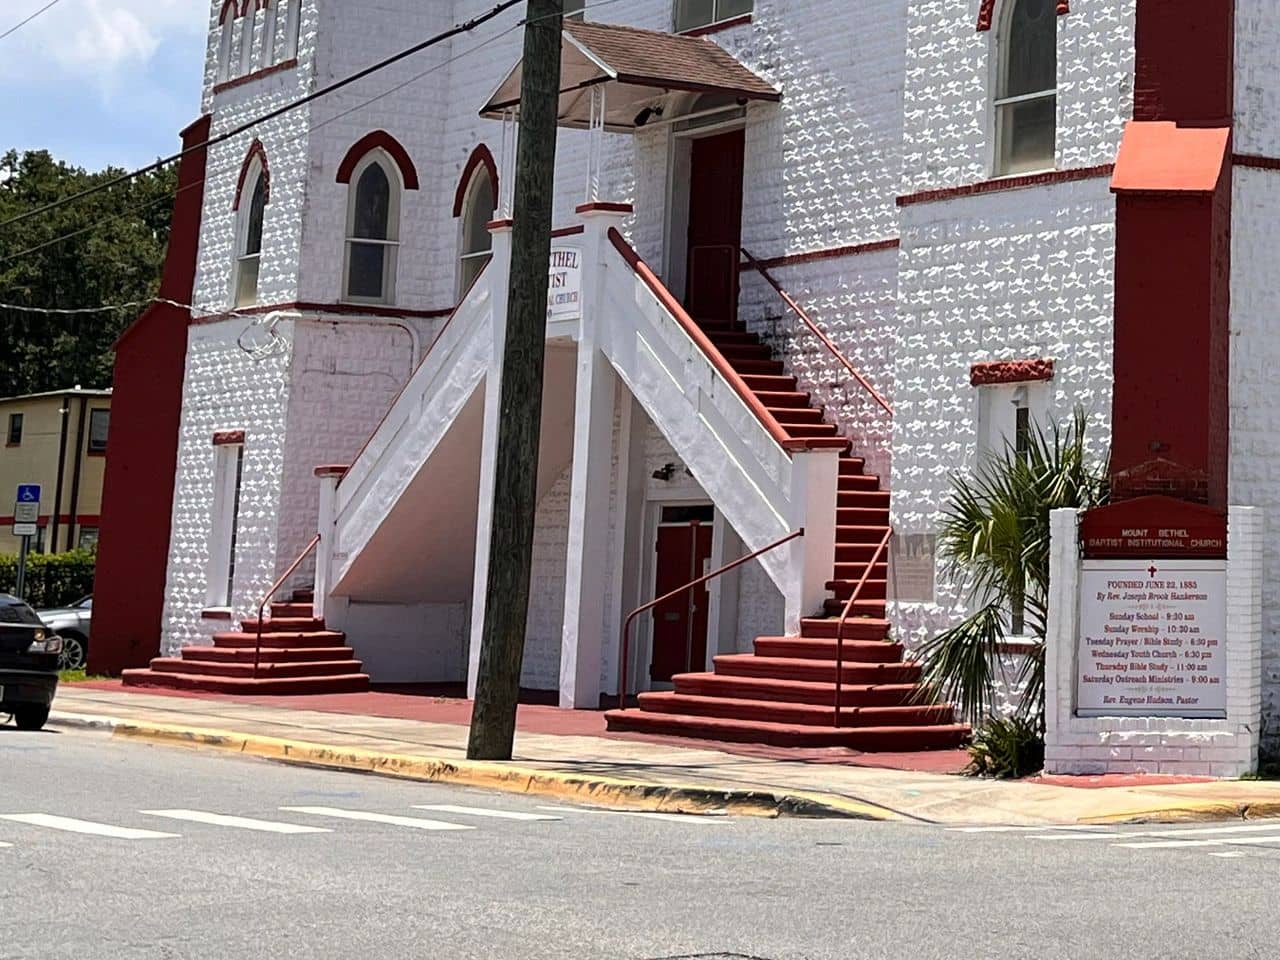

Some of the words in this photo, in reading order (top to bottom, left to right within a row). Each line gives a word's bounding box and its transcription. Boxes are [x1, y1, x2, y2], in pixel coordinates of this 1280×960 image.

[550, 251, 578, 269] THEL
[1122, 529, 1148, 537] MOUNT
[1158, 529, 1189, 537] BETHEL
[1089, 539, 1123, 547] BAPTIST
[1127, 539, 1184, 547] INSTITUTIONAL
[1190, 539, 1222, 547] CHURCH
[1107, 581, 1143, 589] FOUNDED
[1145, 581, 1165, 589] JUNE
[1122, 592, 1147, 602] Joseph
[1109, 612, 1134, 622] Sunday
[1136, 612, 1159, 620] School
[1104, 625, 1129, 634] Sunday
[1131, 625, 1159, 634] Worship
[1086, 637, 1114, 647] Tuesday
[1115, 637, 1139, 647] Prayer
[1144, 637, 1161, 645] Bible
[1163, 637, 1183, 647] Study
[1207, 640, 1218, 648] pm
[1091, 650, 1129, 659] Wednesday
[1131, 650, 1150, 658] Youth
[1152, 650, 1177, 658] Church
[1201, 652, 1212, 660] pm
[1096, 663, 1128, 672] Thursday
[1130, 663, 1147, 671] Bible
[1149, 663, 1169, 672] Study
[1083, 675, 1114, 685] Saturday
[1115, 675, 1147, 683] Outreach
[1149, 675, 1184, 683] Ministries
[1119, 696, 1145, 706] Eugene
[1176, 696, 1199, 704] Pastor
